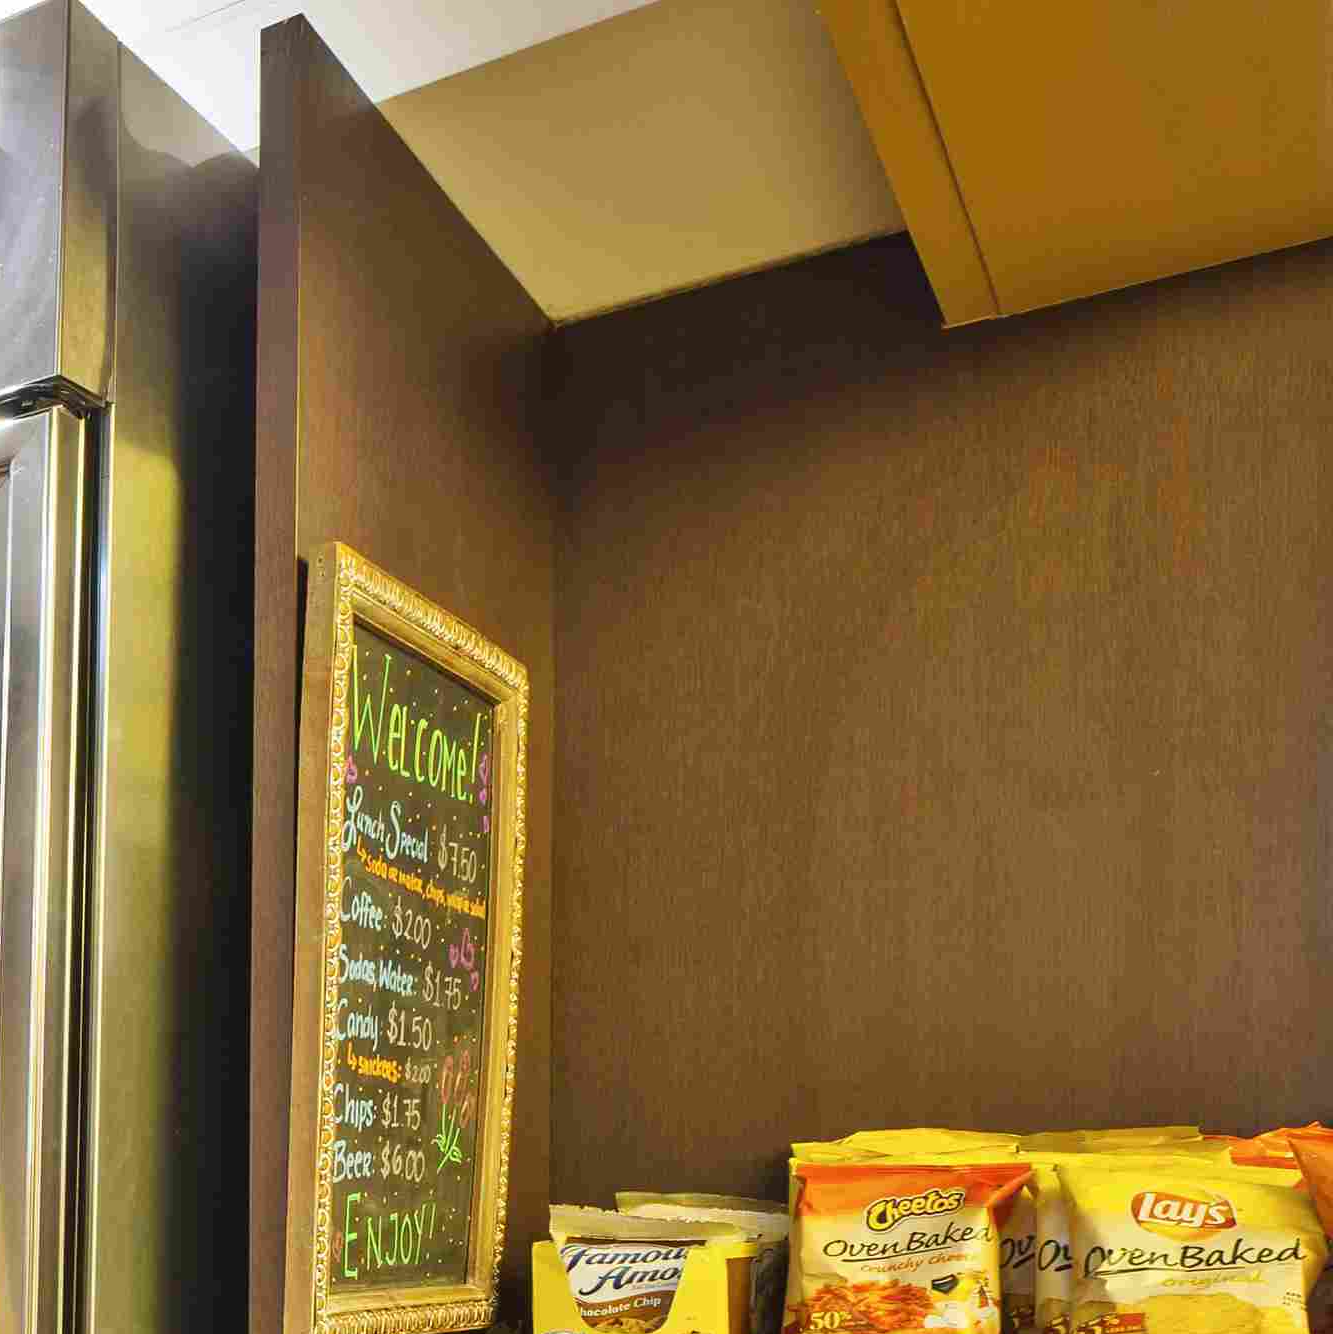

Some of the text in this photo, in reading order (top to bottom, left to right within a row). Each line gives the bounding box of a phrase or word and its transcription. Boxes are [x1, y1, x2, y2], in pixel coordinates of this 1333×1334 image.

[341, 786, 385, 852] Lunch
[387, 1000, 433, 1051] $1.50
[381, 1091, 421, 1131] $1.75
[380, 1141, 426, 1184] $6.00
[866, 1188, 965, 1232] Cheetos
[1137, 1190, 1231, 1229] Lay's
[560, 1243, 689, 1273] Famou
[822, 1222, 994, 1260] Oven Baked
[1179, 1238, 1307, 1269] Baked
[578, 1264, 681, 1297] Amo
[579, 1296, 663, 1319] hocolate Chip
